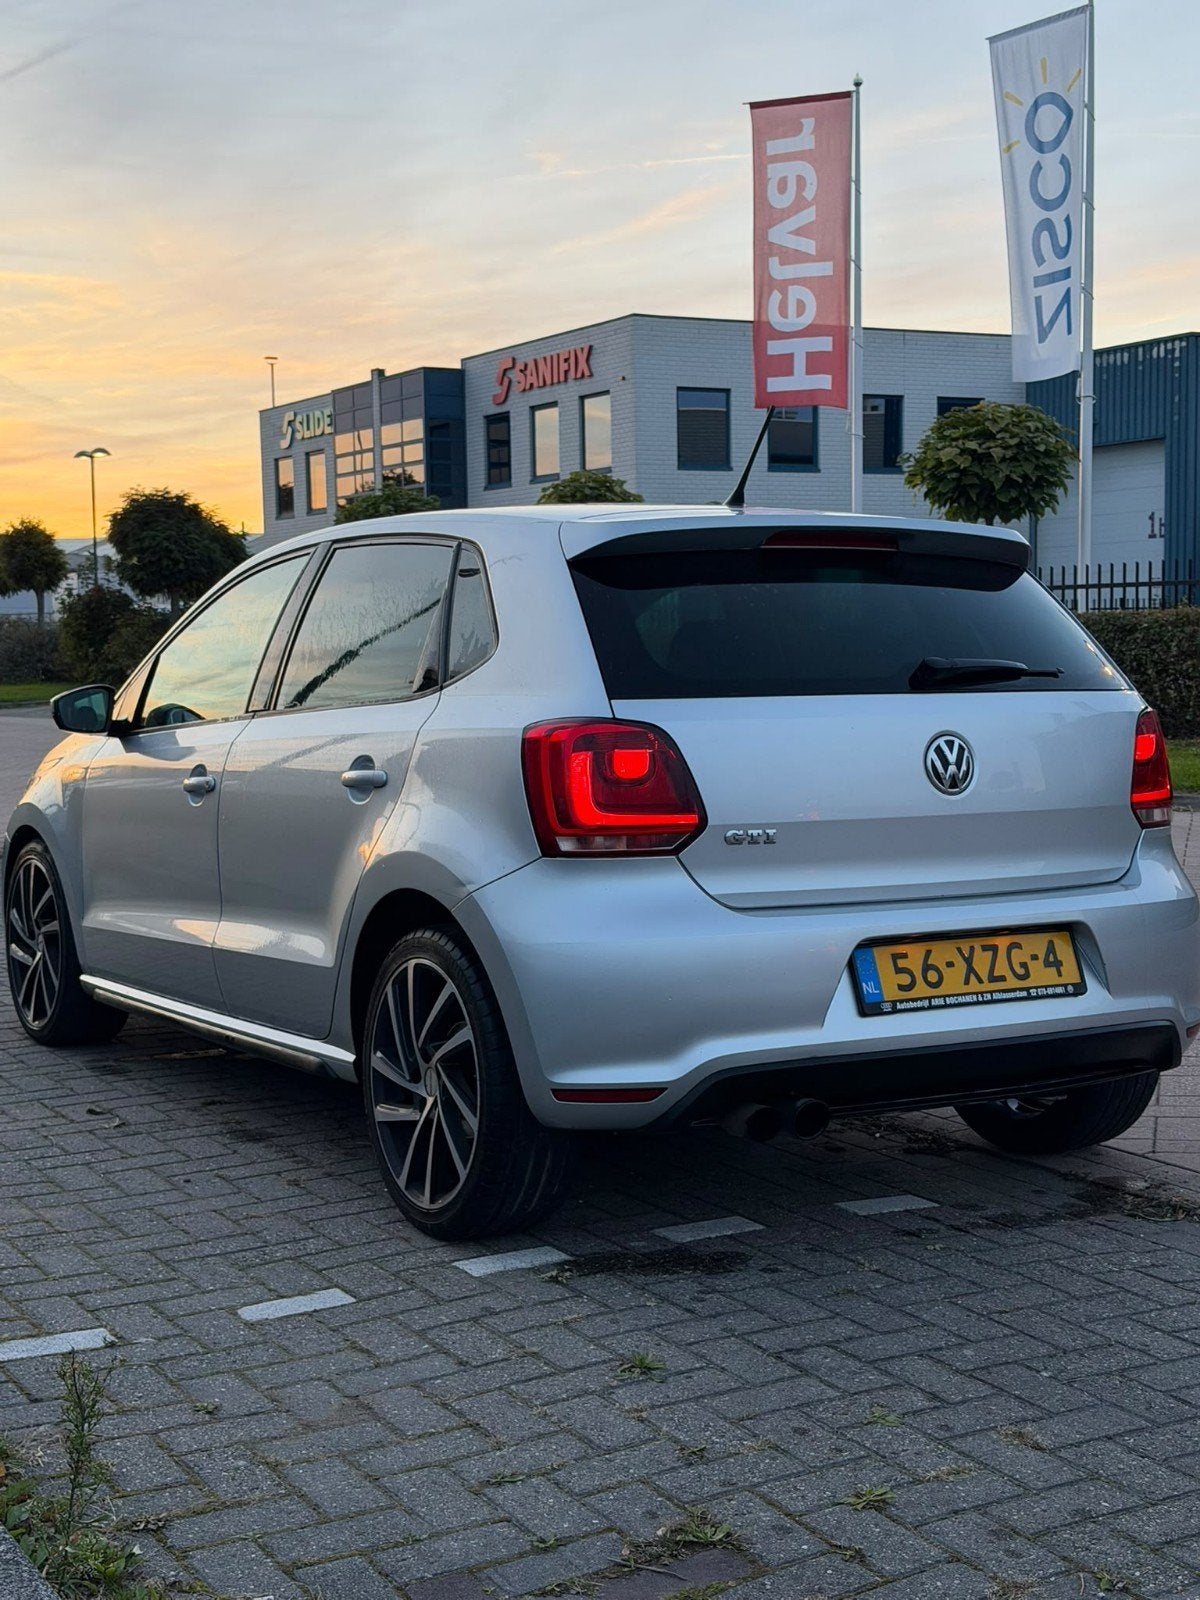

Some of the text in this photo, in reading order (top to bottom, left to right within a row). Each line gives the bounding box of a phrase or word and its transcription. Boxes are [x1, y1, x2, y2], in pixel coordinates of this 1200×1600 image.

[514, 345, 593, 393] SANIFIX
[295, 408, 333, 440] SLIDE
[724, 828, 777, 846] GTI
[890, 939, 1064, 992] 56-XZG-4
[862, 982, 880, 994] NL
